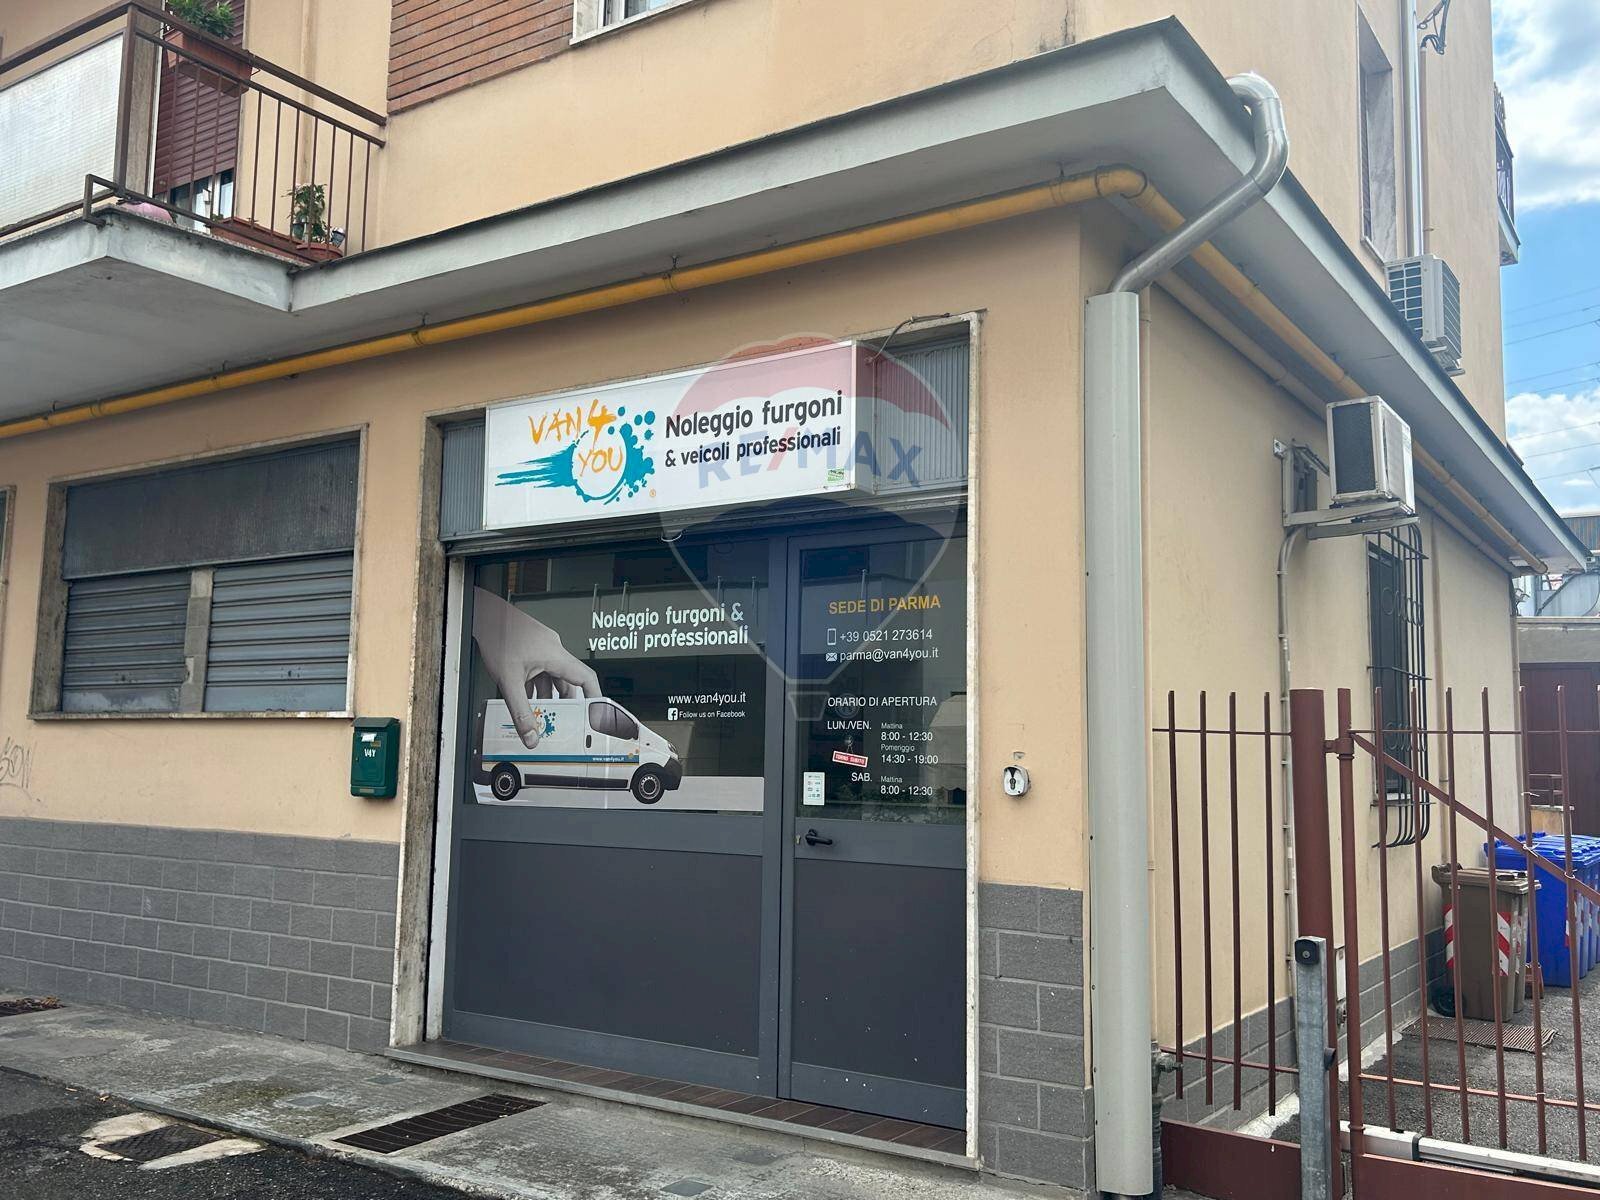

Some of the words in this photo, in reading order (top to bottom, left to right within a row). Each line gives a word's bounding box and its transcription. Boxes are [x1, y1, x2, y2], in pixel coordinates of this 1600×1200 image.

[665, 405, 753, 438] Noleggio
[762, 390, 842, 425] furgoni
[665, 449, 677, 467] &
[681, 441, 730, 467] veicoli
[736, 426, 841, 462] professionali
[578, 446, 624, 477] YOU
[829, 600, 866, 615] SEDE
[870, 599, 884, 612] DI
[889, 595, 941, 611] PARMA
[592, 607, 659, 631] Noleggio
[666, 602, 725, 627] furgoni
[731, 602, 744, 622] &
[589, 631, 638, 651] veicoli
[644, 624, 749, 652] professionali
[840, 631, 860, 643] +39
[863, 630, 888, 642] 0521
[892, 628, 933, 641] 273614
[840, 647, 939, 663] parma@van4you.it
[668, 691, 747, 706] www.van4you.it
[827, 697, 866, 707] ORARIO
[868, 697, 879, 707] DI
[881, 696, 938, 707] APERTURA
[716, 710, 746, 718] Facebook
[881, 731, 900, 741] 8:00
[909, 731, 933, 741] 12:30
[880, 744, 915, 752] Pomeriggio
[881, 754, 906, 764] 14:30
[914, 755, 939, 764] 19:00
[851, 772, 872, 782] SAB.
[880, 785, 899, 795] 8:00
[908, 786, 933, 796] 12:30
